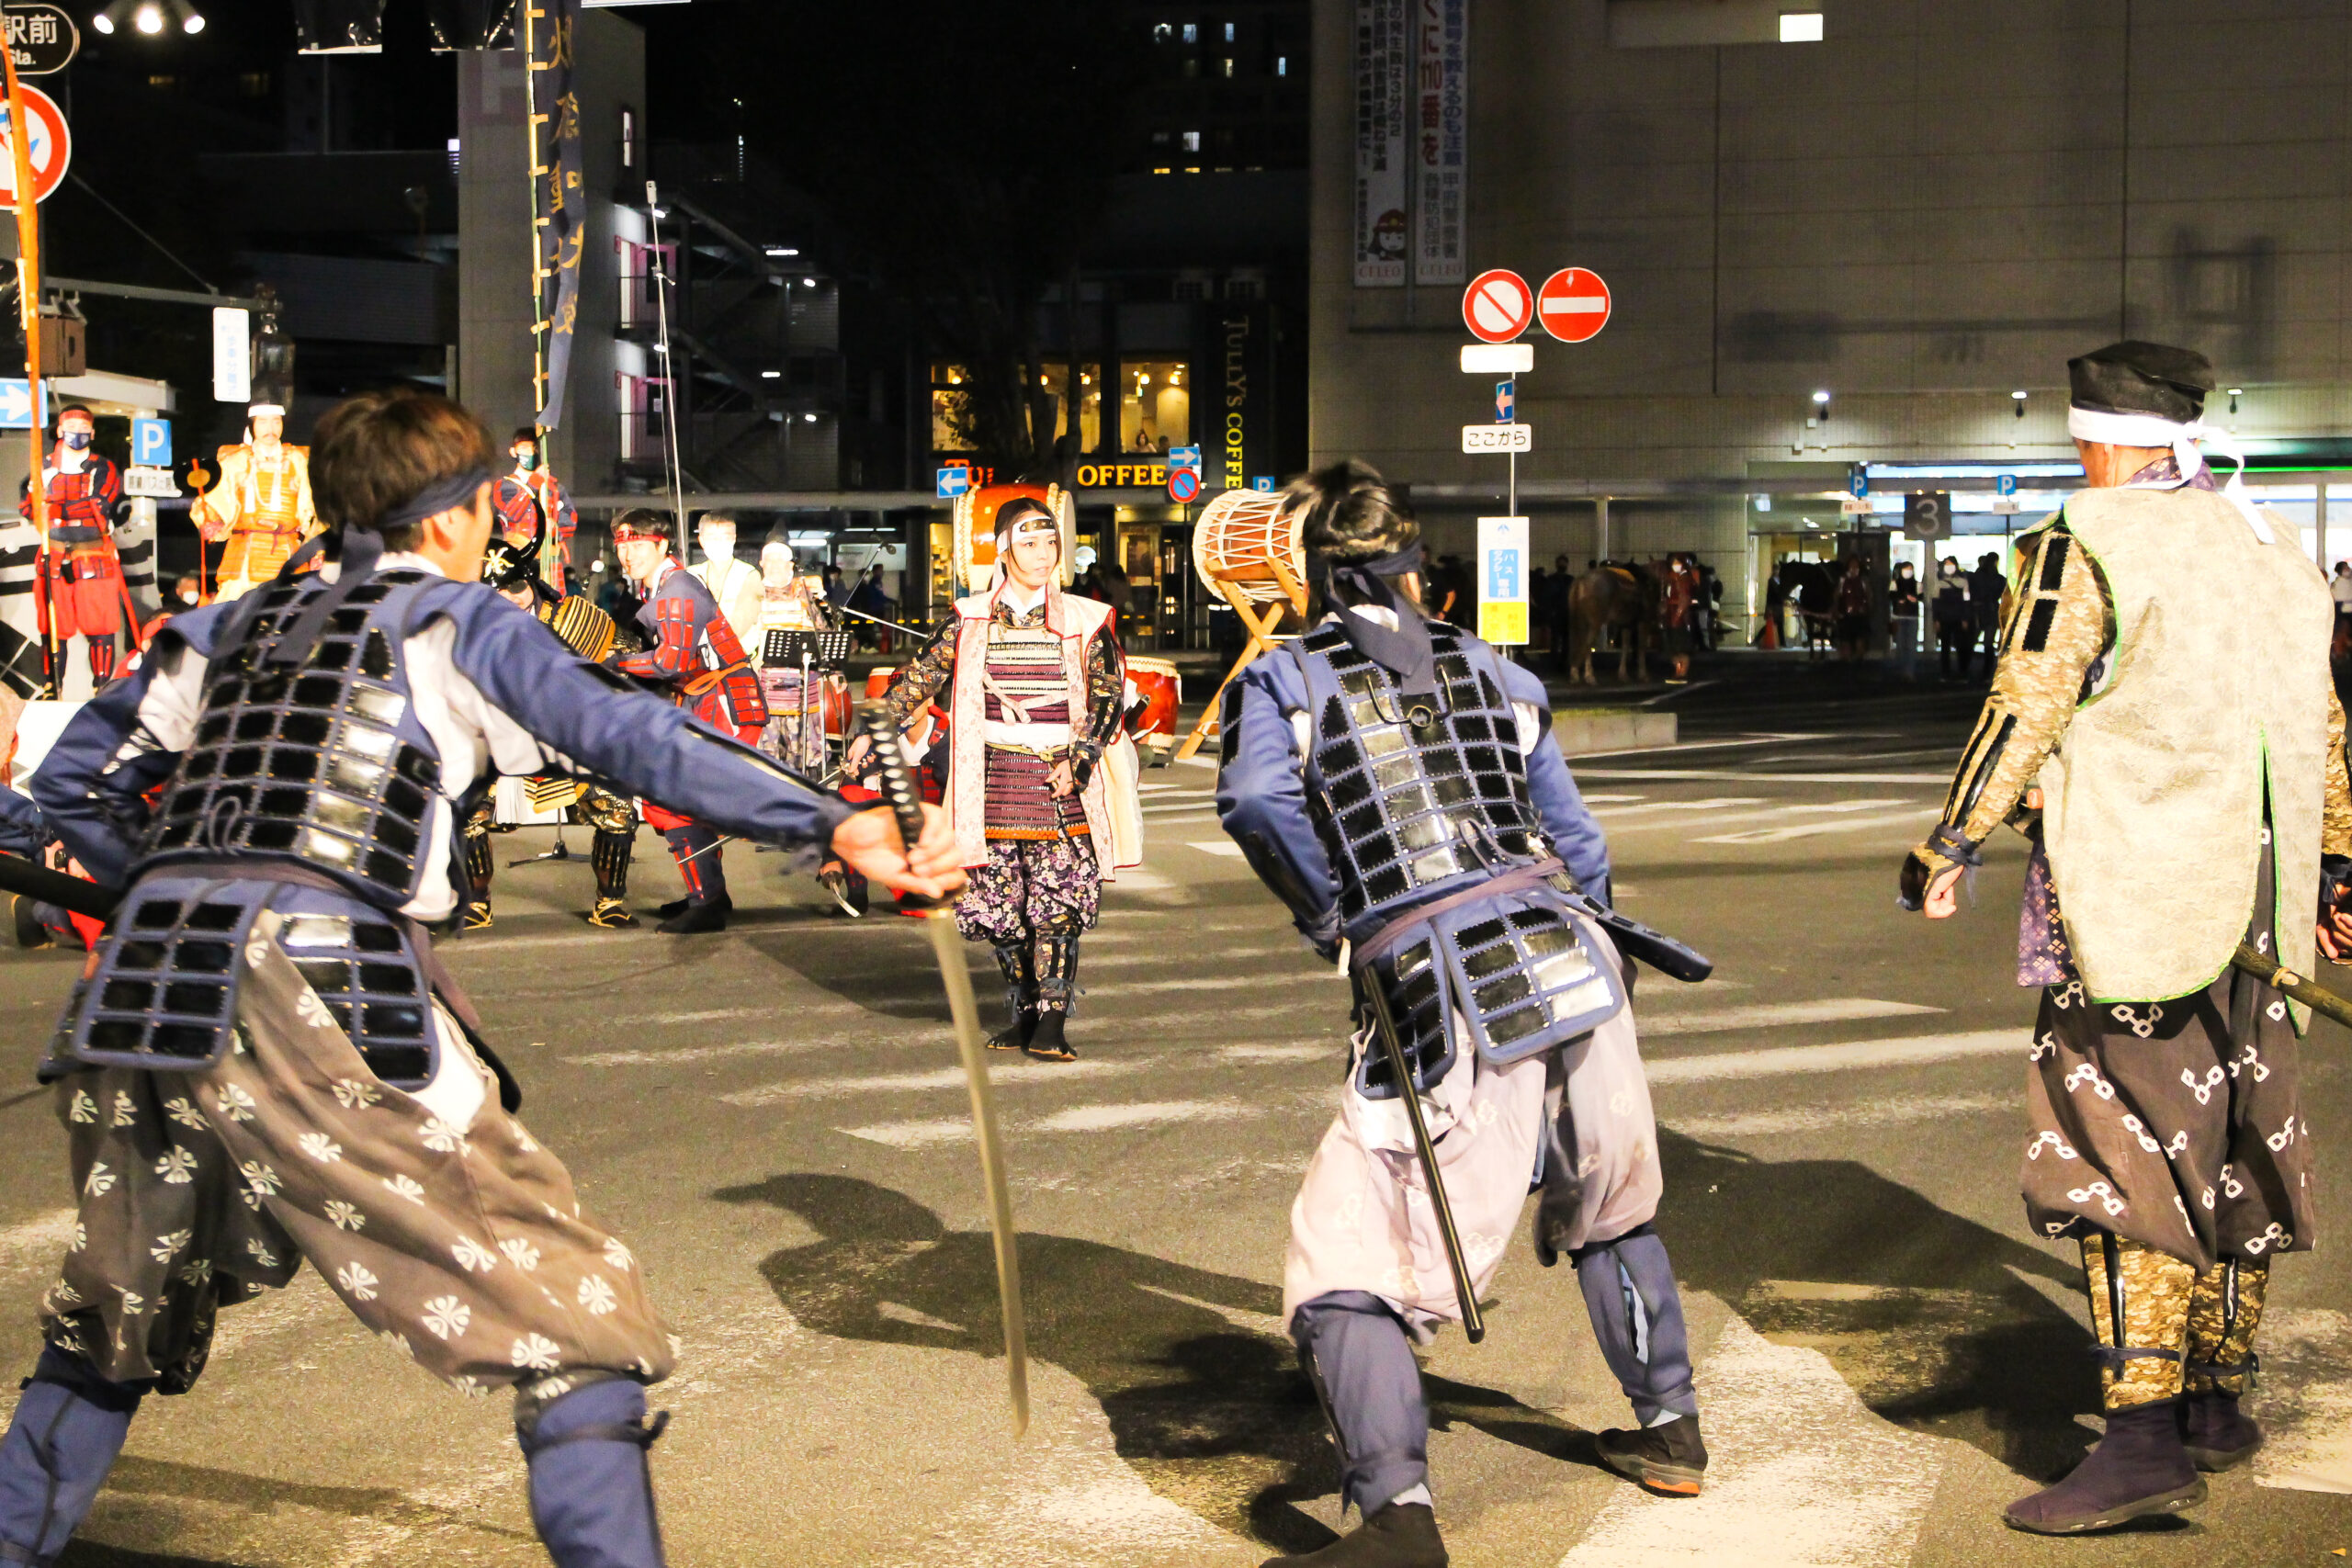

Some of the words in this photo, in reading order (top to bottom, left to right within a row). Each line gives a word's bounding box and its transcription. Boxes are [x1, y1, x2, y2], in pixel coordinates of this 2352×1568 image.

[142, 423, 164, 460] P
[1468, 431, 1527, 446] ここから
[1226, 412, 1243, 490] COFFE
[1077, 465, 1168, 486] OFFEE
[1258, 479, 1271, 491] P
[1853, 476, 1865, 494] P
[2001, 476, 2013, 494] P
[1915, 499, 1939, 535] 3
